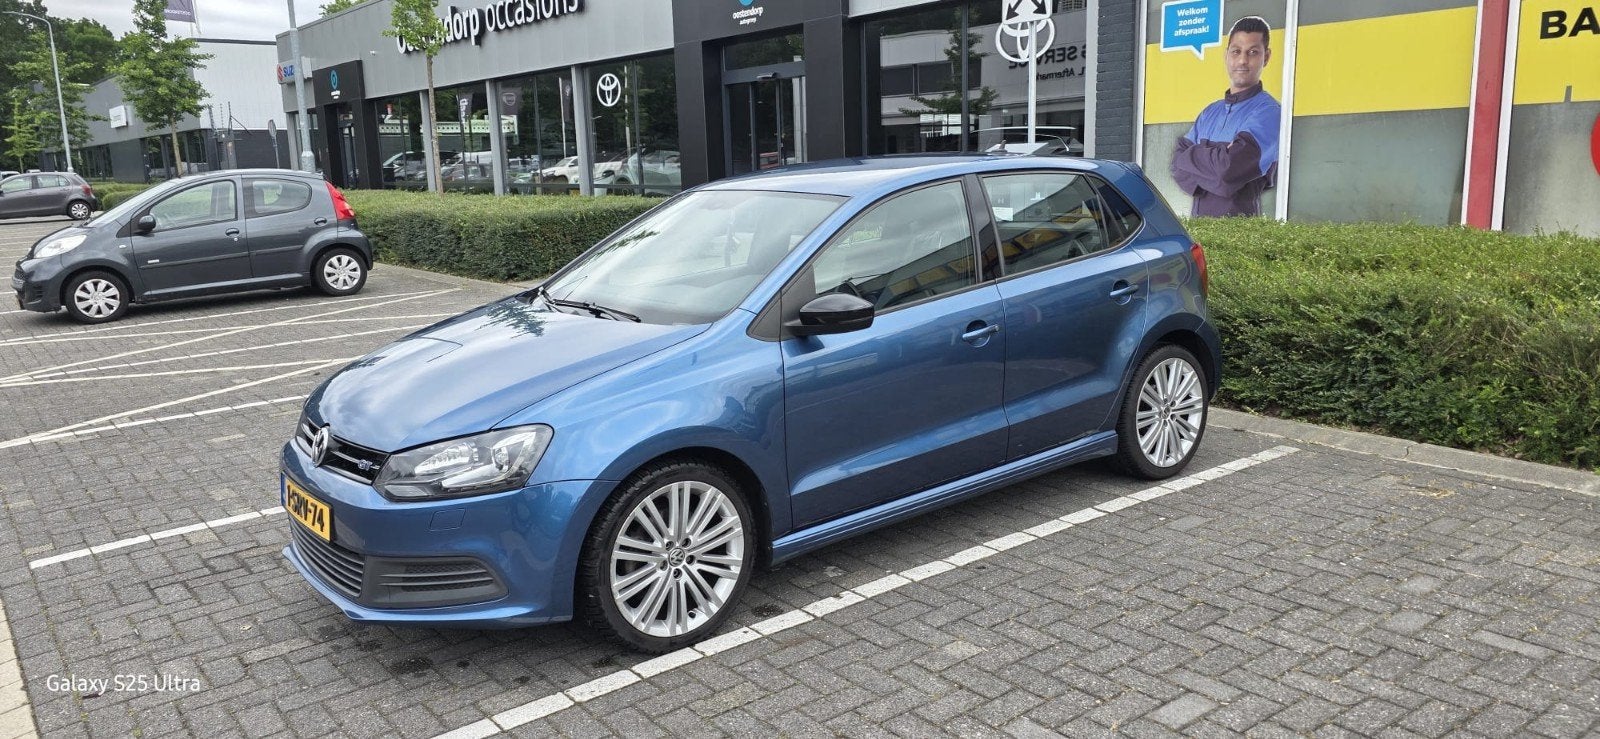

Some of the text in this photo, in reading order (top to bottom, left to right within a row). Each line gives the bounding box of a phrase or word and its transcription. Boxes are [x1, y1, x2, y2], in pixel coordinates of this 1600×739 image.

[732, 6, 763, 19] oestendorp
[1177, 7, 1209, 17] Welkom
[1179, 17, 1206, 26] zonder
[1540, 6, 1600, 40] BA
[1174, 25, 1210, 37] afspraak!
